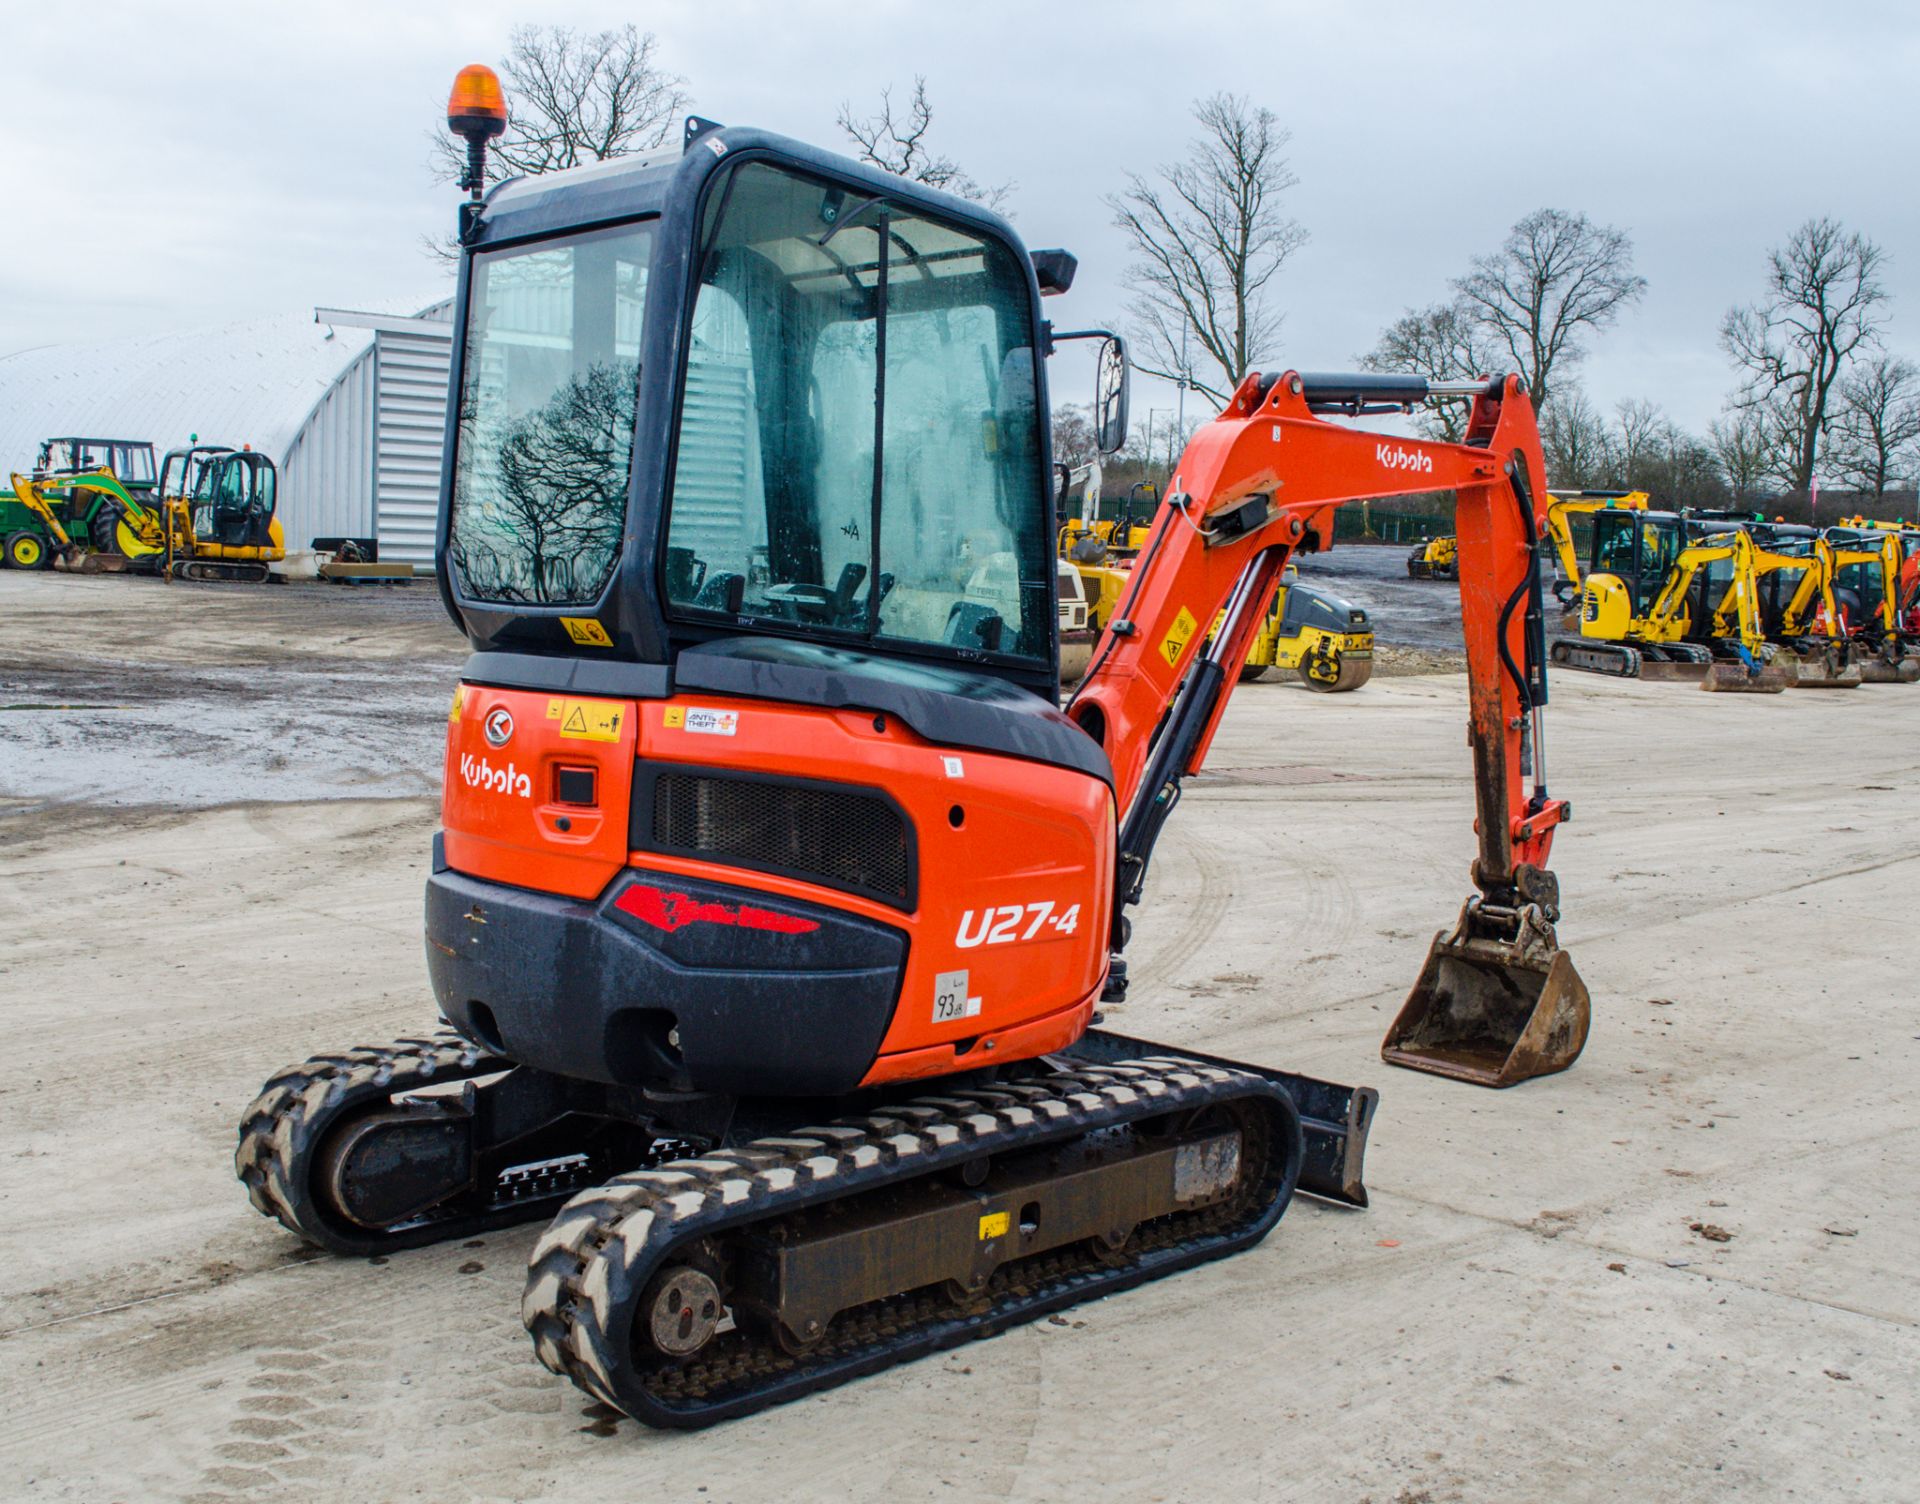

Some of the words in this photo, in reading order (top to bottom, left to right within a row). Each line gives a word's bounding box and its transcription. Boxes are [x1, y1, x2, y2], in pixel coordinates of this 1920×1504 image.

[1376, 443, 1433, 473] Kubota
[687, 720, 716, 729] THEFT
[460, 752, 532, 799] Kubota
[955, 901, 1081, 949] U27-4
